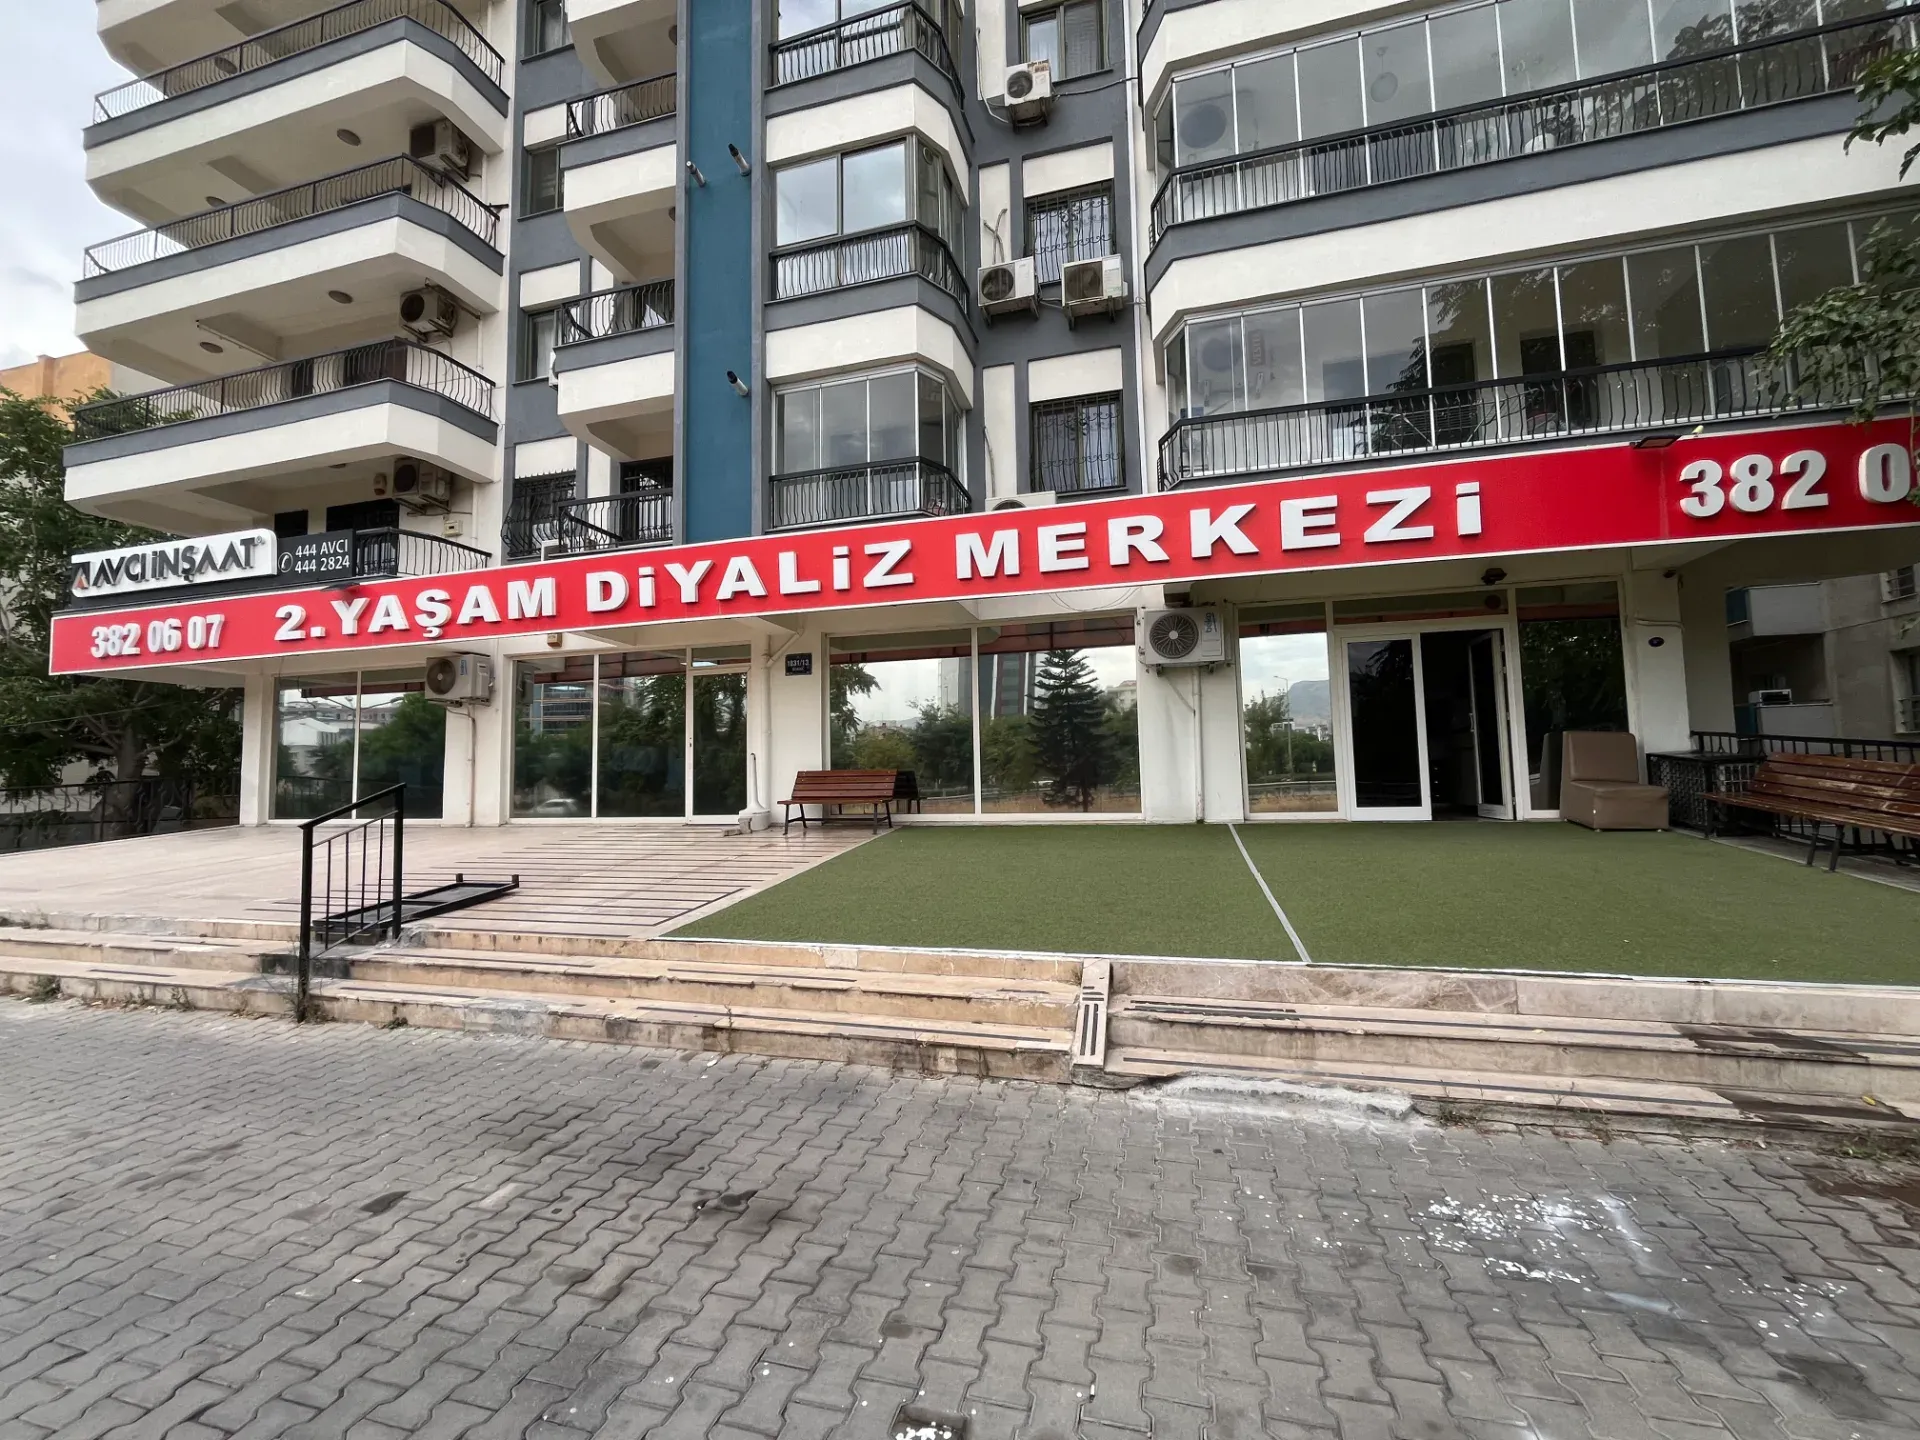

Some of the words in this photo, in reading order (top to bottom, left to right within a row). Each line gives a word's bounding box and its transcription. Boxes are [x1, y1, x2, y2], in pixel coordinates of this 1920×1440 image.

[1679, 450, 1829, 518] 382
[295, 544, 316, 557] 444
[320, 539, 348, 555] AVCI
[295, 559, 316, 573] 444
[320, 555, 350, 571] 2824
[92, 553, 148, 587] AVCI
[90, 623, 141, 658] 382
[147, 618, 182, 652] 06
[187, 614, 225, 649] 07
